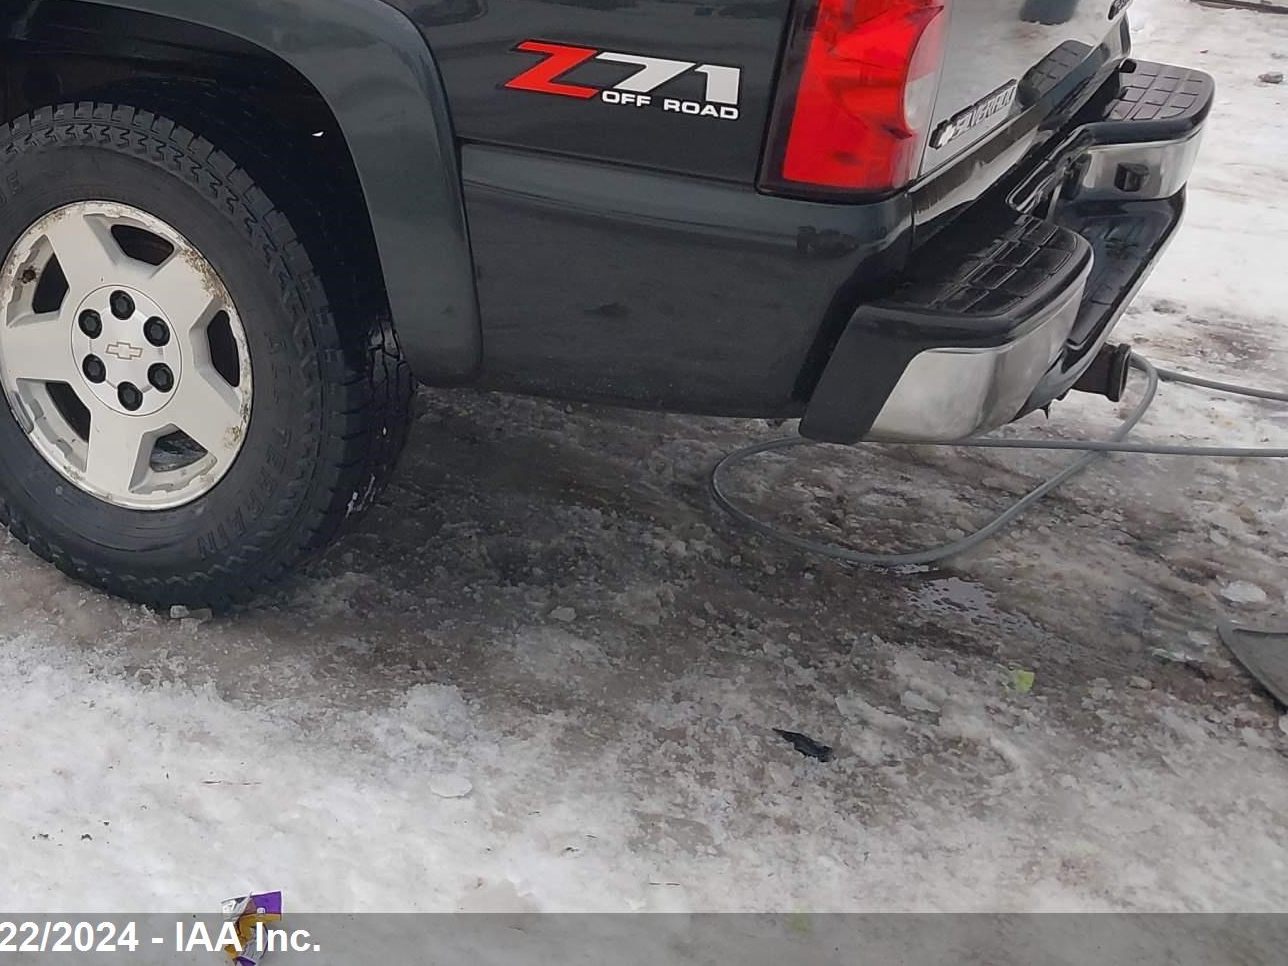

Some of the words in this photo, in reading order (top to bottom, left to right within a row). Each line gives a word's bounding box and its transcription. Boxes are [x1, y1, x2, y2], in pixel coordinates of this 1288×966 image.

[505, 39, 741, 105] Z71
[601, 90, 652, 107] OFF
[662, 99, 740, 120] ROAD
